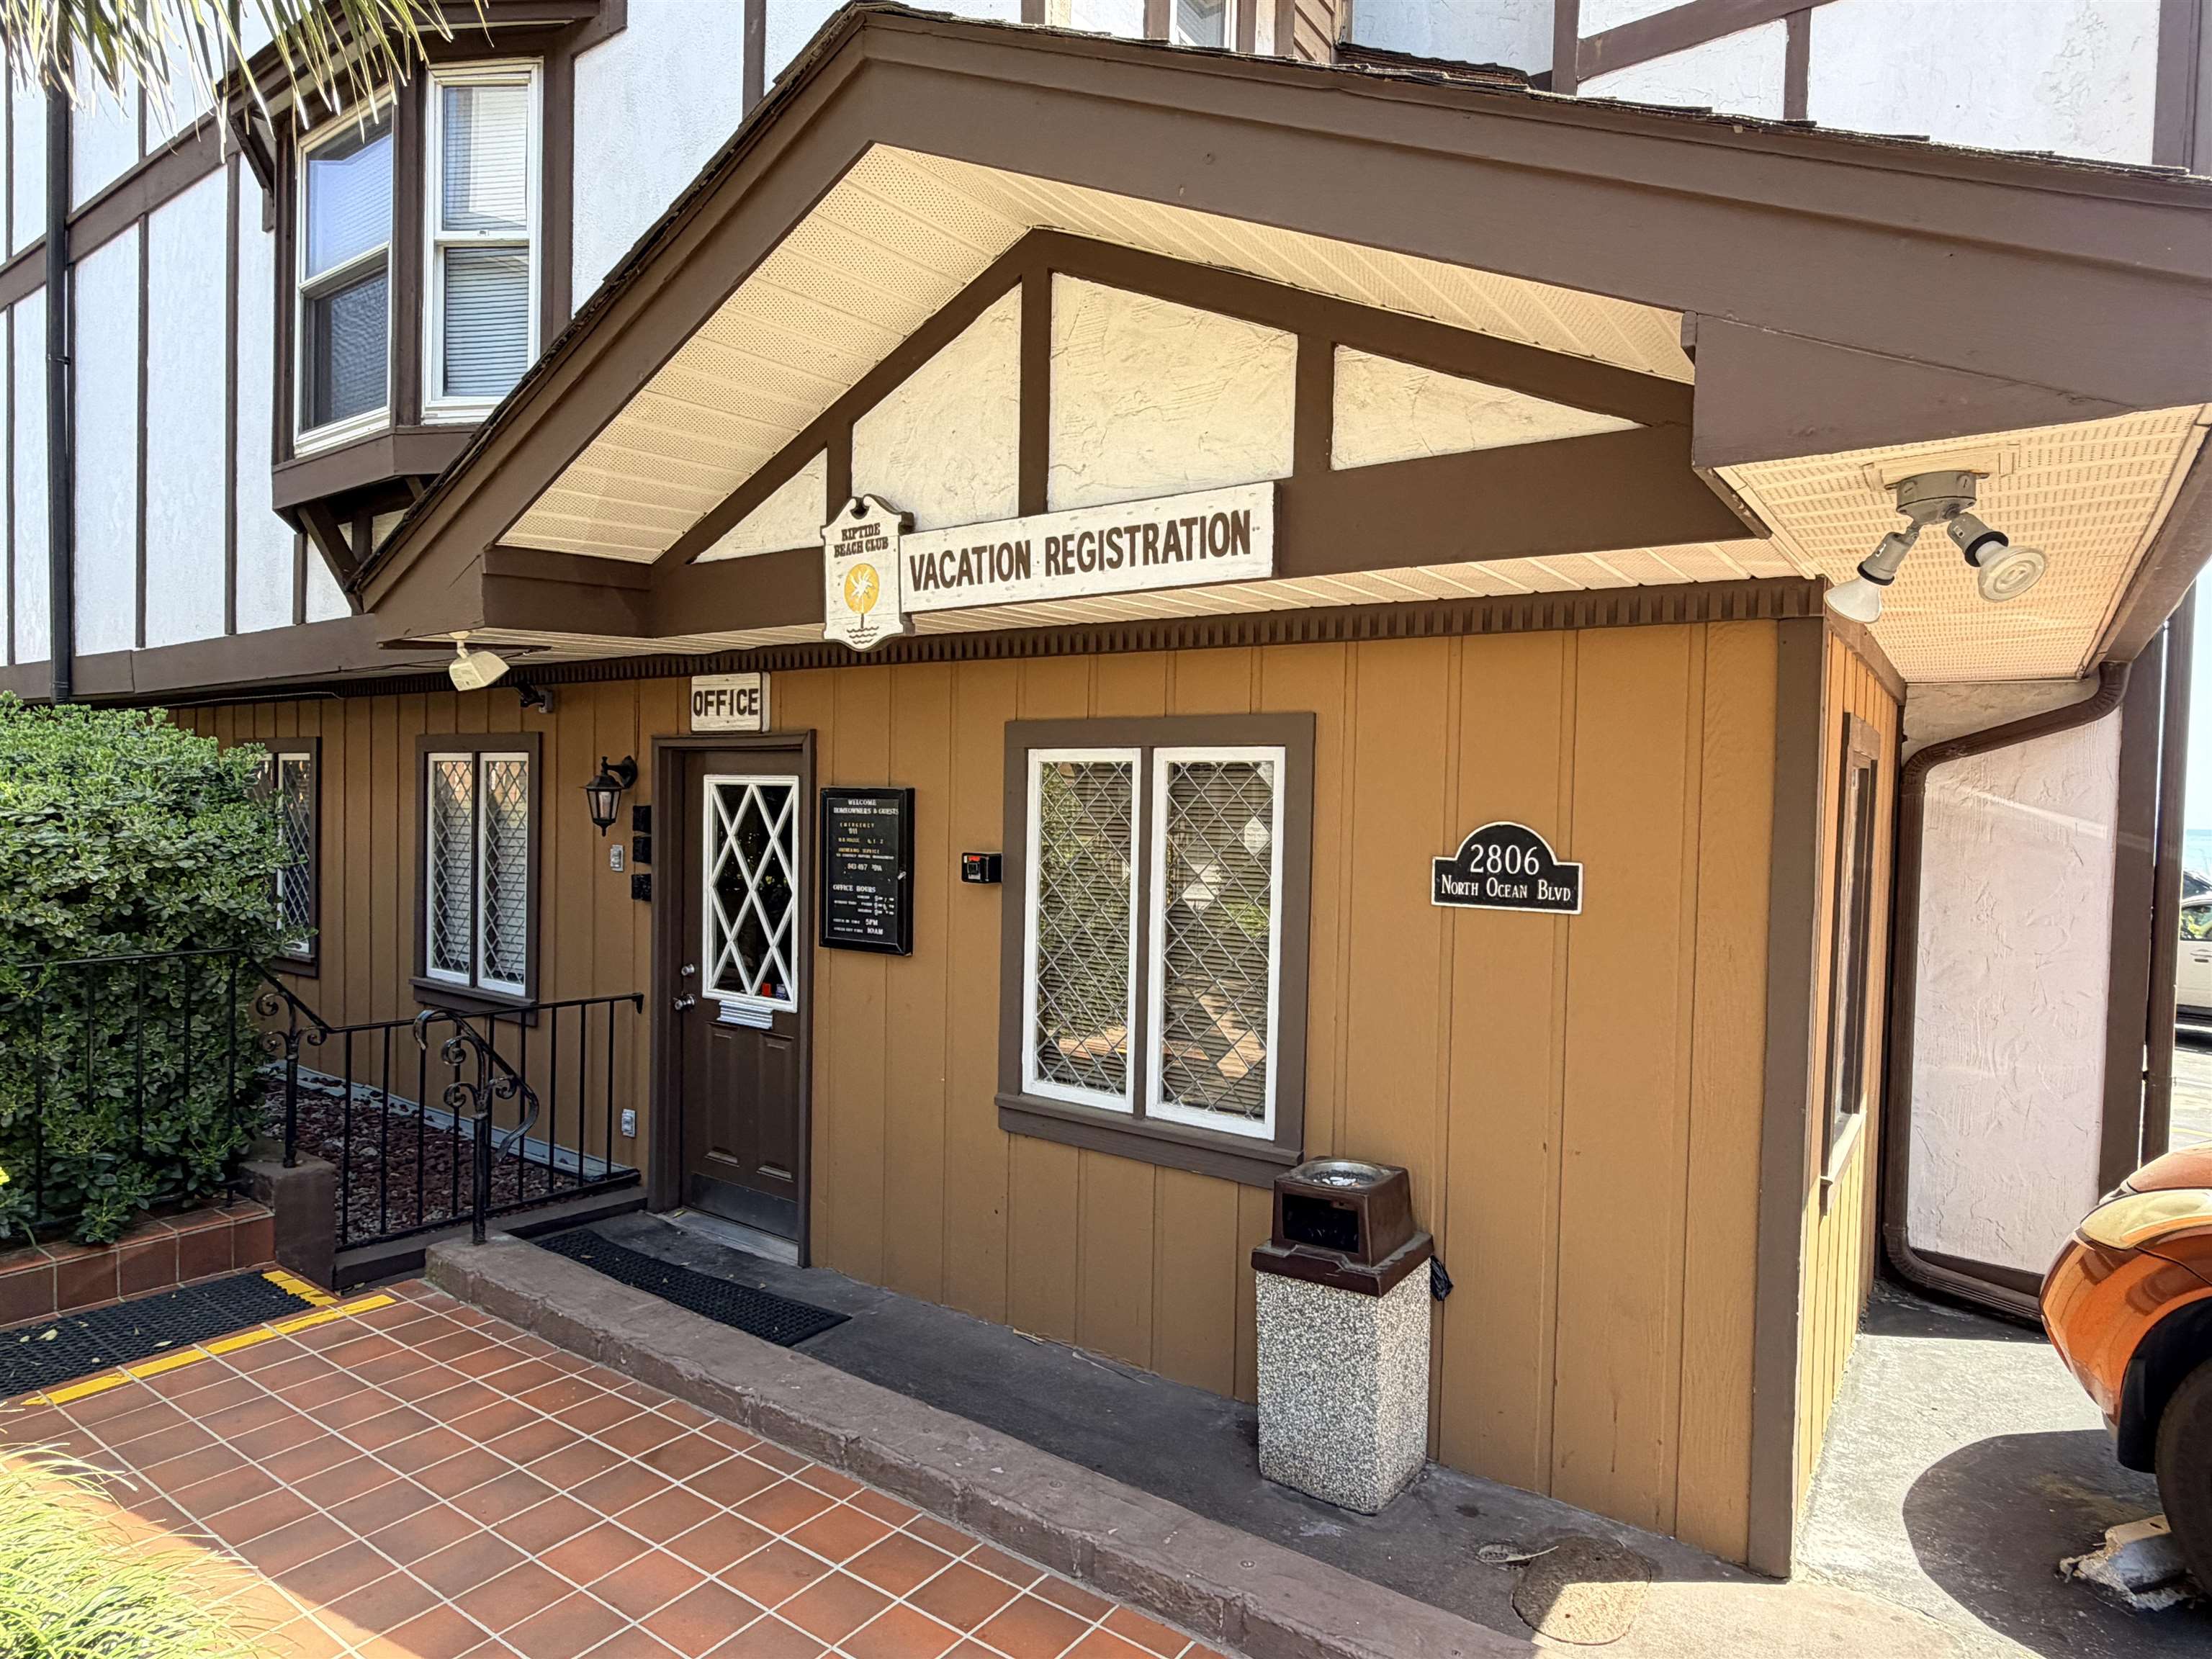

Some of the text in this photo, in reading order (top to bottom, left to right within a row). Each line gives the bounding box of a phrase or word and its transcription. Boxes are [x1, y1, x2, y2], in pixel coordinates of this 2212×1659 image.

[841, 522, 881, 541] RIPTIDE
[834, 536, 889, 558] BEACH CLUB
[909, 509, 1251, 592] VACATION REGISTRATION
[693, 688, 759, 716] OFFICE
[1470, 844, 1539, 876] 2806
[867, 927, 884, 935] 10AM
